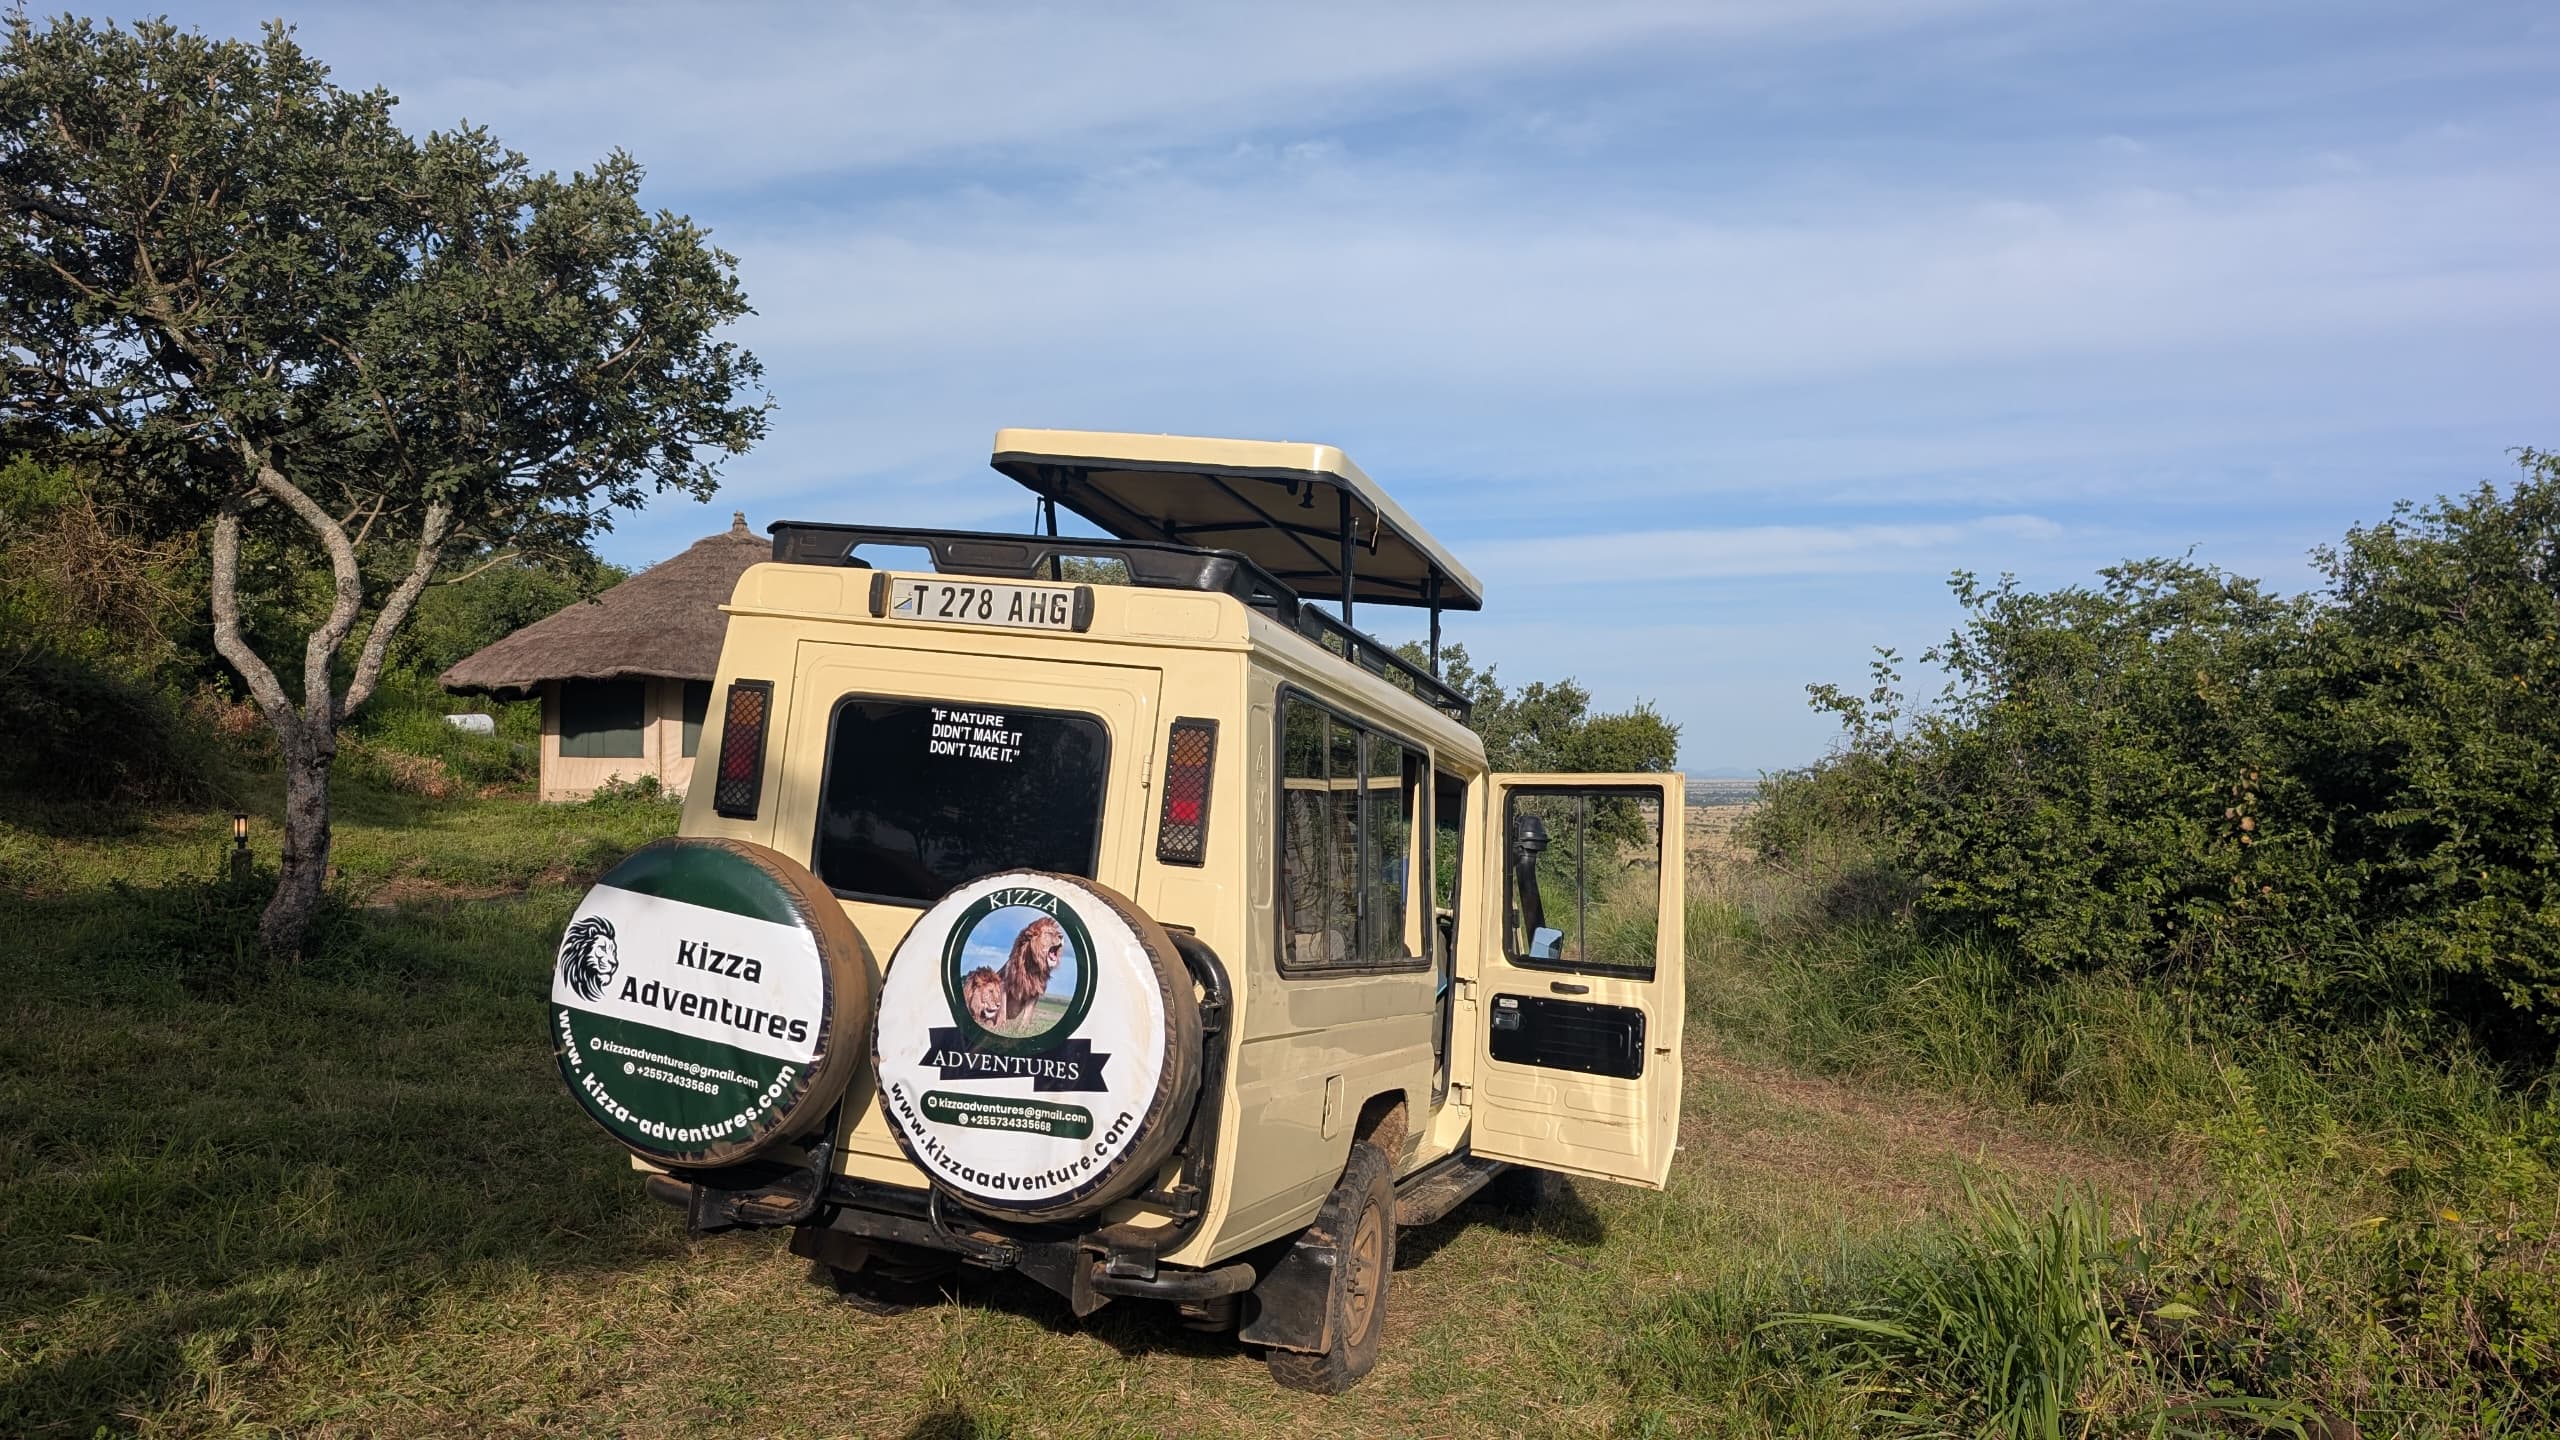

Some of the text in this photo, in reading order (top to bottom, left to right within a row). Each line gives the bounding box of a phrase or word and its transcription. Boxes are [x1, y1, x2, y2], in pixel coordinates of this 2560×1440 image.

[913, 584, 1068, 625] T 278 AHG
[931, 723, 1023, 746] DIDN'T MAKE IT
[950, 711, 1005, 727] NATURE
[929, 740, 967, 757] DON'T
[968, 744, 999, 761] TAKE
[988, 889, 1059, 916] KIZZA
[675, 938, 763, 985] Kizza
[617, 975, 809, 1043] Adventures
[602, 1039, 760, 1089] kizzaadventures@gmail.com
[932, 1049, 1080, 1081] ADVENTURES
[636, 1066, 720, 1096] +255734335668
[938, 1097, 1088, 1125] kizzaadventures@gmail.com
[890, 1081, 1135, 1191] www.kizzaadventure.com
